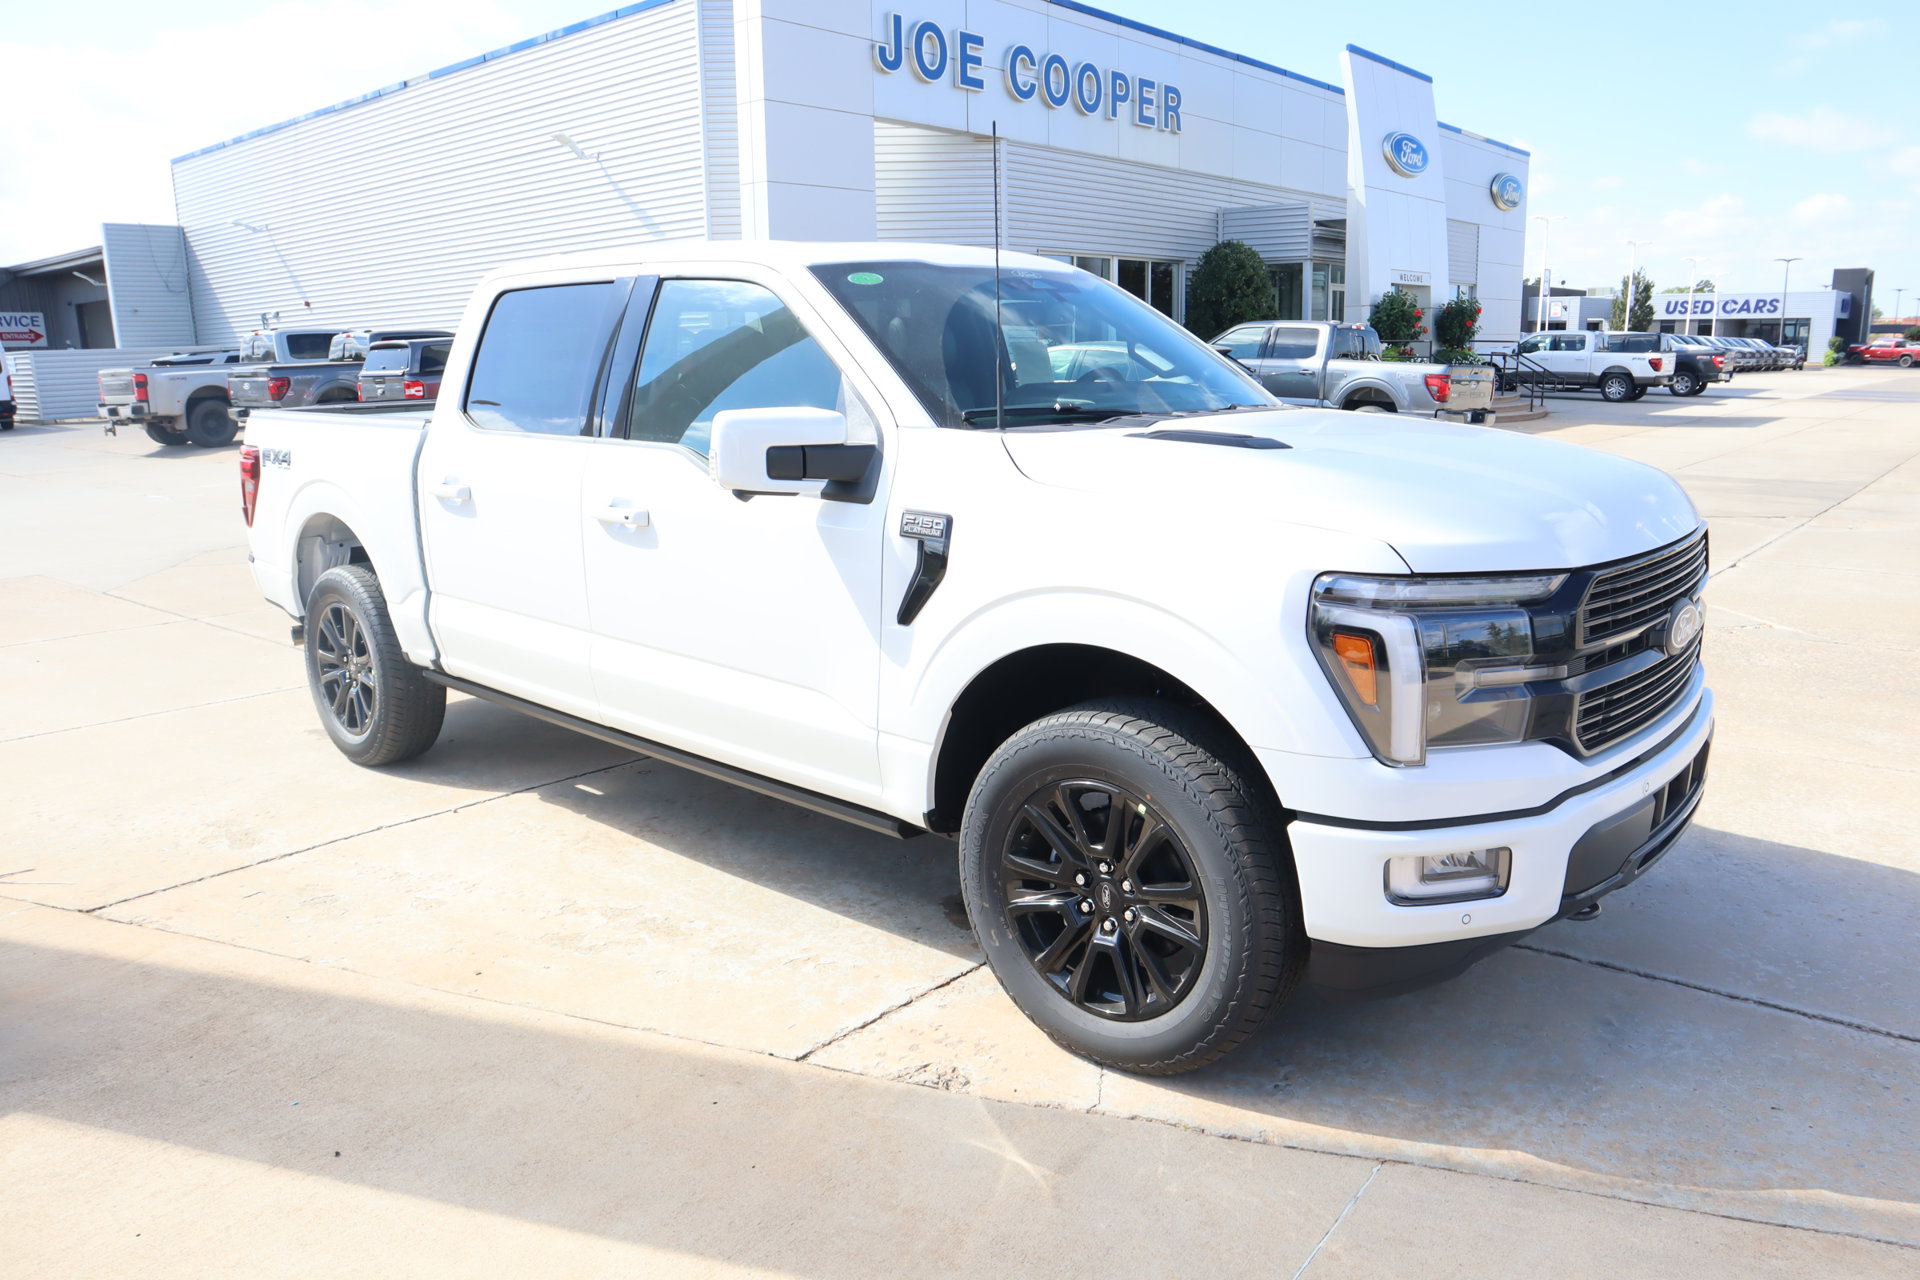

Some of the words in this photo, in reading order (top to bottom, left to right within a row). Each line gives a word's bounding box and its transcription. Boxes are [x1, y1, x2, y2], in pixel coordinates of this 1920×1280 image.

[873, 11, 985, 91] JOE
[1005, 44, 1182, 134] COOPER
[1401, 140, 1424, 167] Ford
[1503, 181, 1520, 202] Ford
[1400, 273, 1423, 283] WELCOME
[1665, 300, 1715, 315] USED
[1721, 298, 1780, 314] CARS
[2, 332, 35, 340] ENTRANCE
[262, 448, 291, 467] FX4
[903, 515, 944, 530] F-150
[903, 525, 942, 537] PLATINUM
